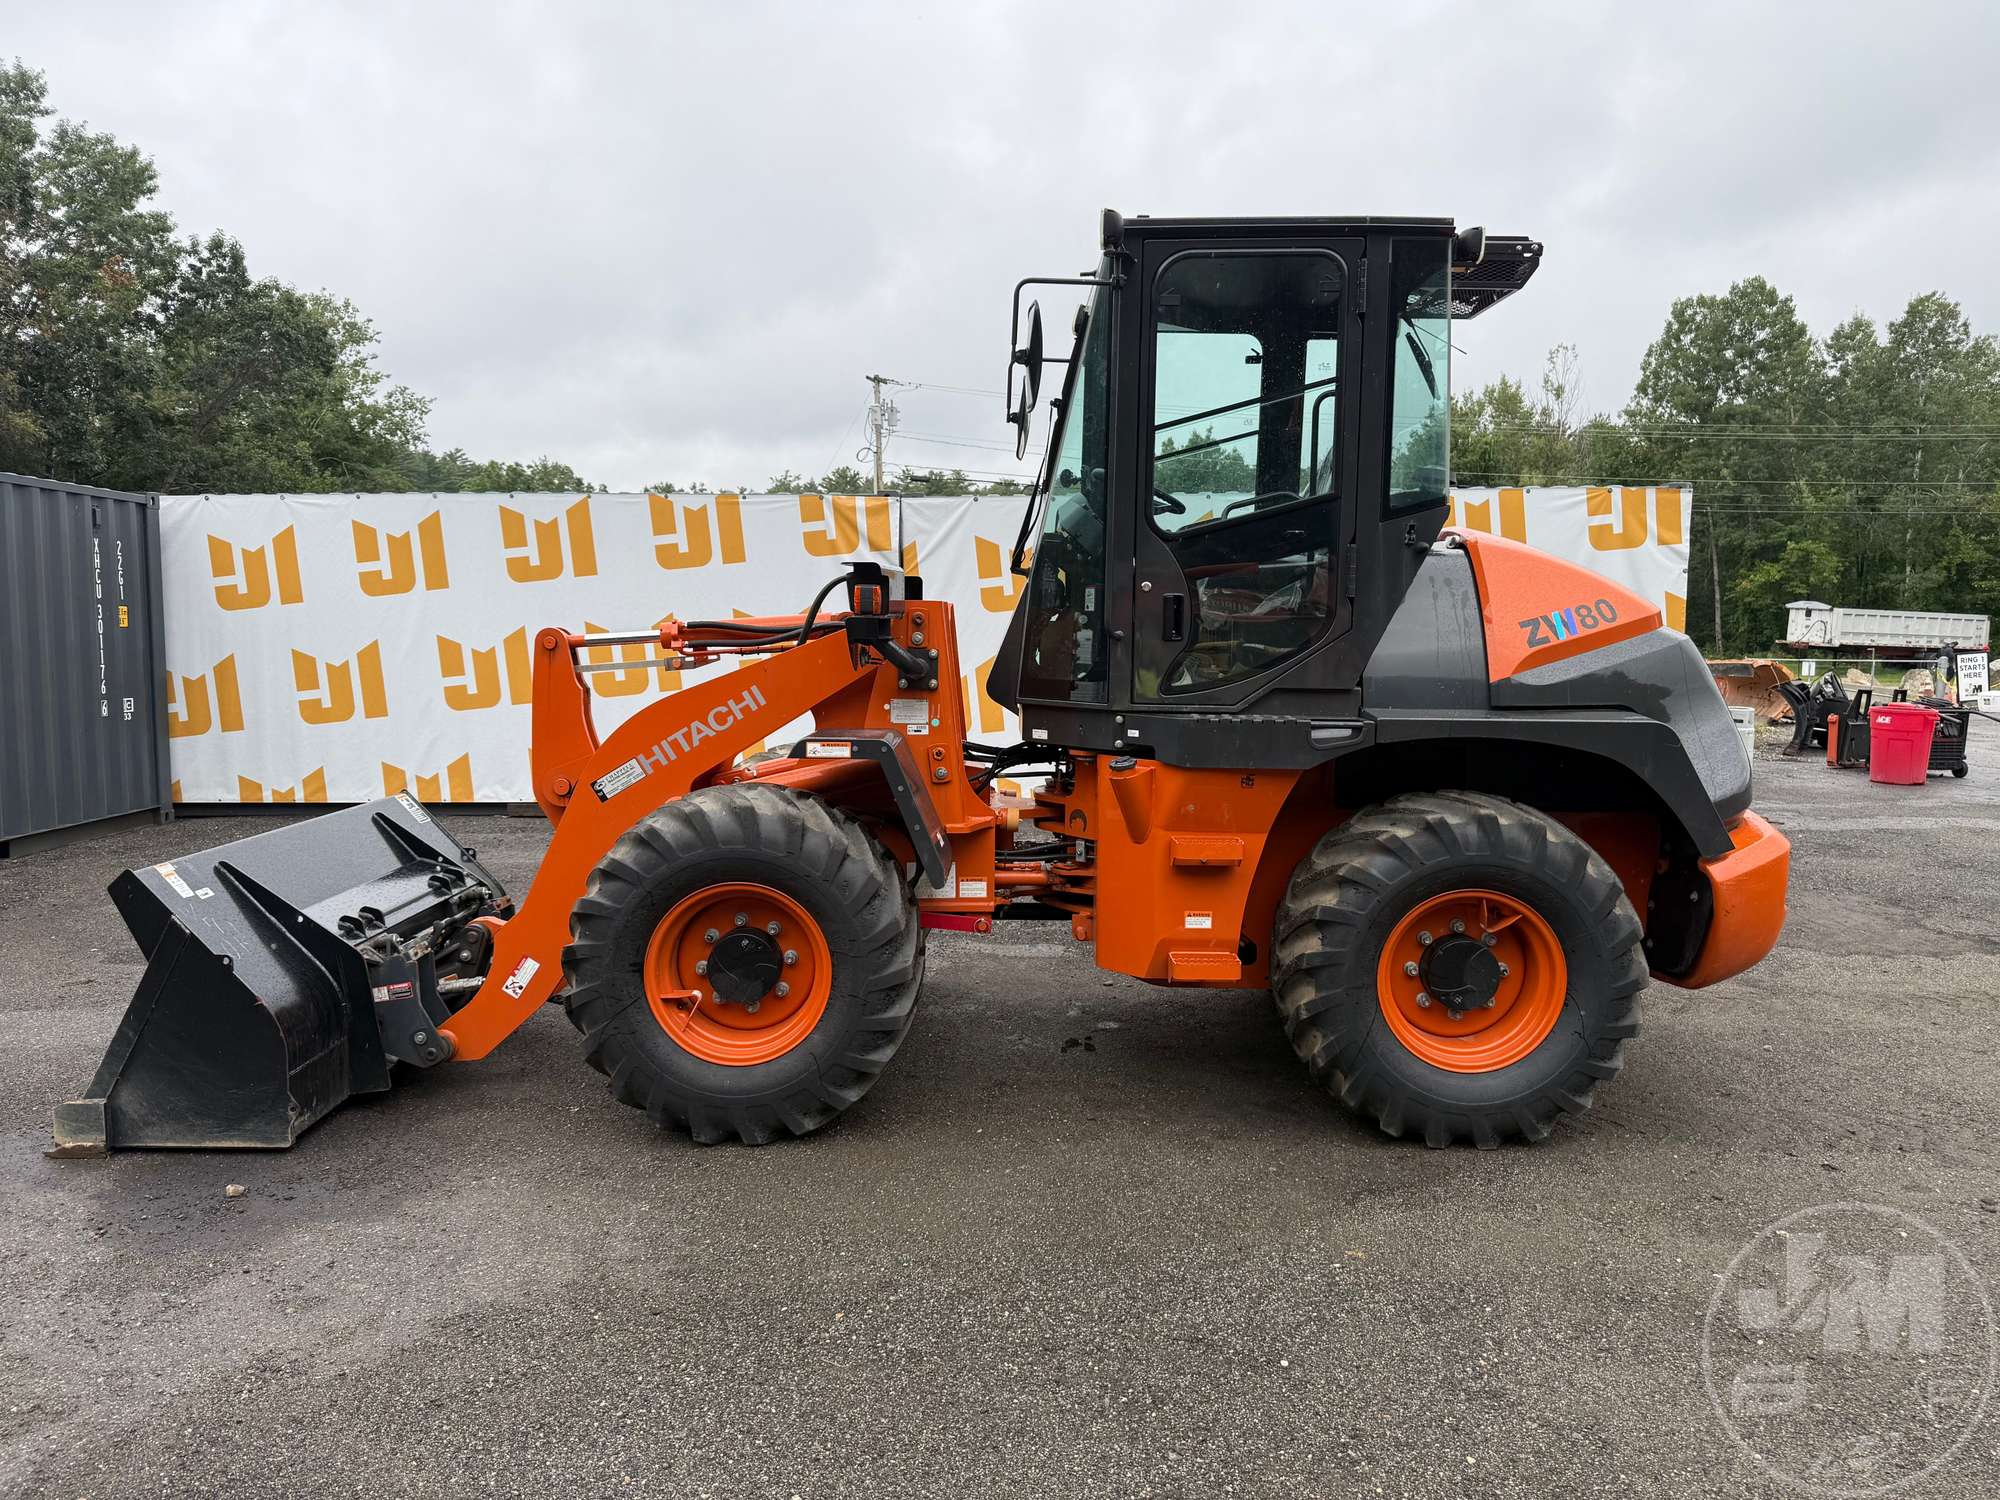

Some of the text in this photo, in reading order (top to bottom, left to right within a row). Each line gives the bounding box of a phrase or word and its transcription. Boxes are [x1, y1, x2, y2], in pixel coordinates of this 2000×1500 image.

[93, 538, 102, 599] XHCU
[116, 540, 124, 600] 22G1
[97, 604, 106, 695] 301176
[1519, 598, 1618, 648] ZW80
[1959, 663, 1986, 672] STARTS
[1960, 656, 1978, 664] RING
[638, 684, 767, 775] HITACHI
[1875, 715, 1893, 724] ACE
